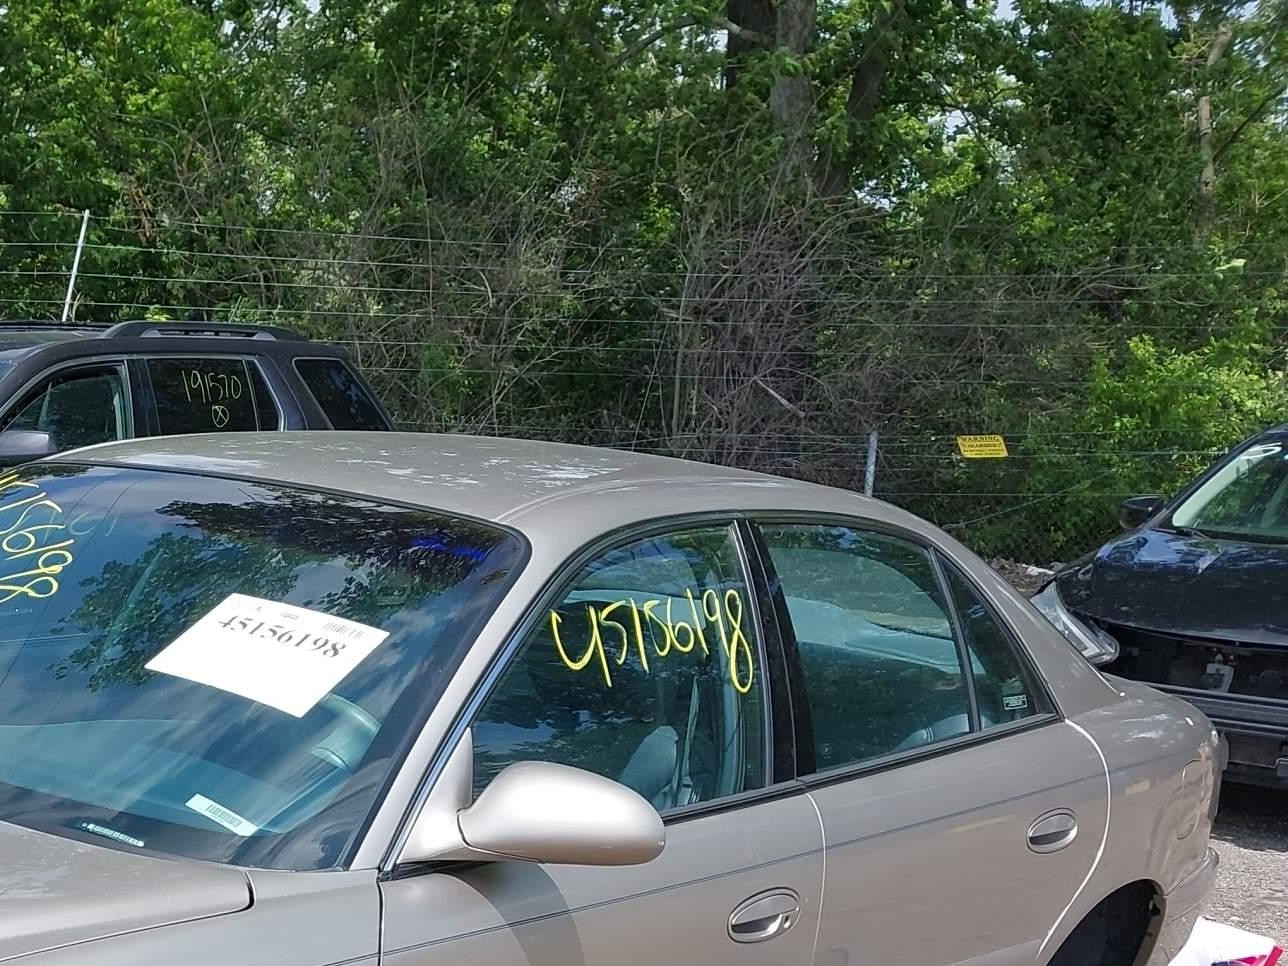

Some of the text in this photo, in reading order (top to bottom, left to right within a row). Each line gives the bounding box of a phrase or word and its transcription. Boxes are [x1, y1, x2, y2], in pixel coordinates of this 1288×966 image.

[181, 369, 242, 404] 191570
[217, 614, 347, 659] 45156198
[550, 587, 754, 694] 45156198
